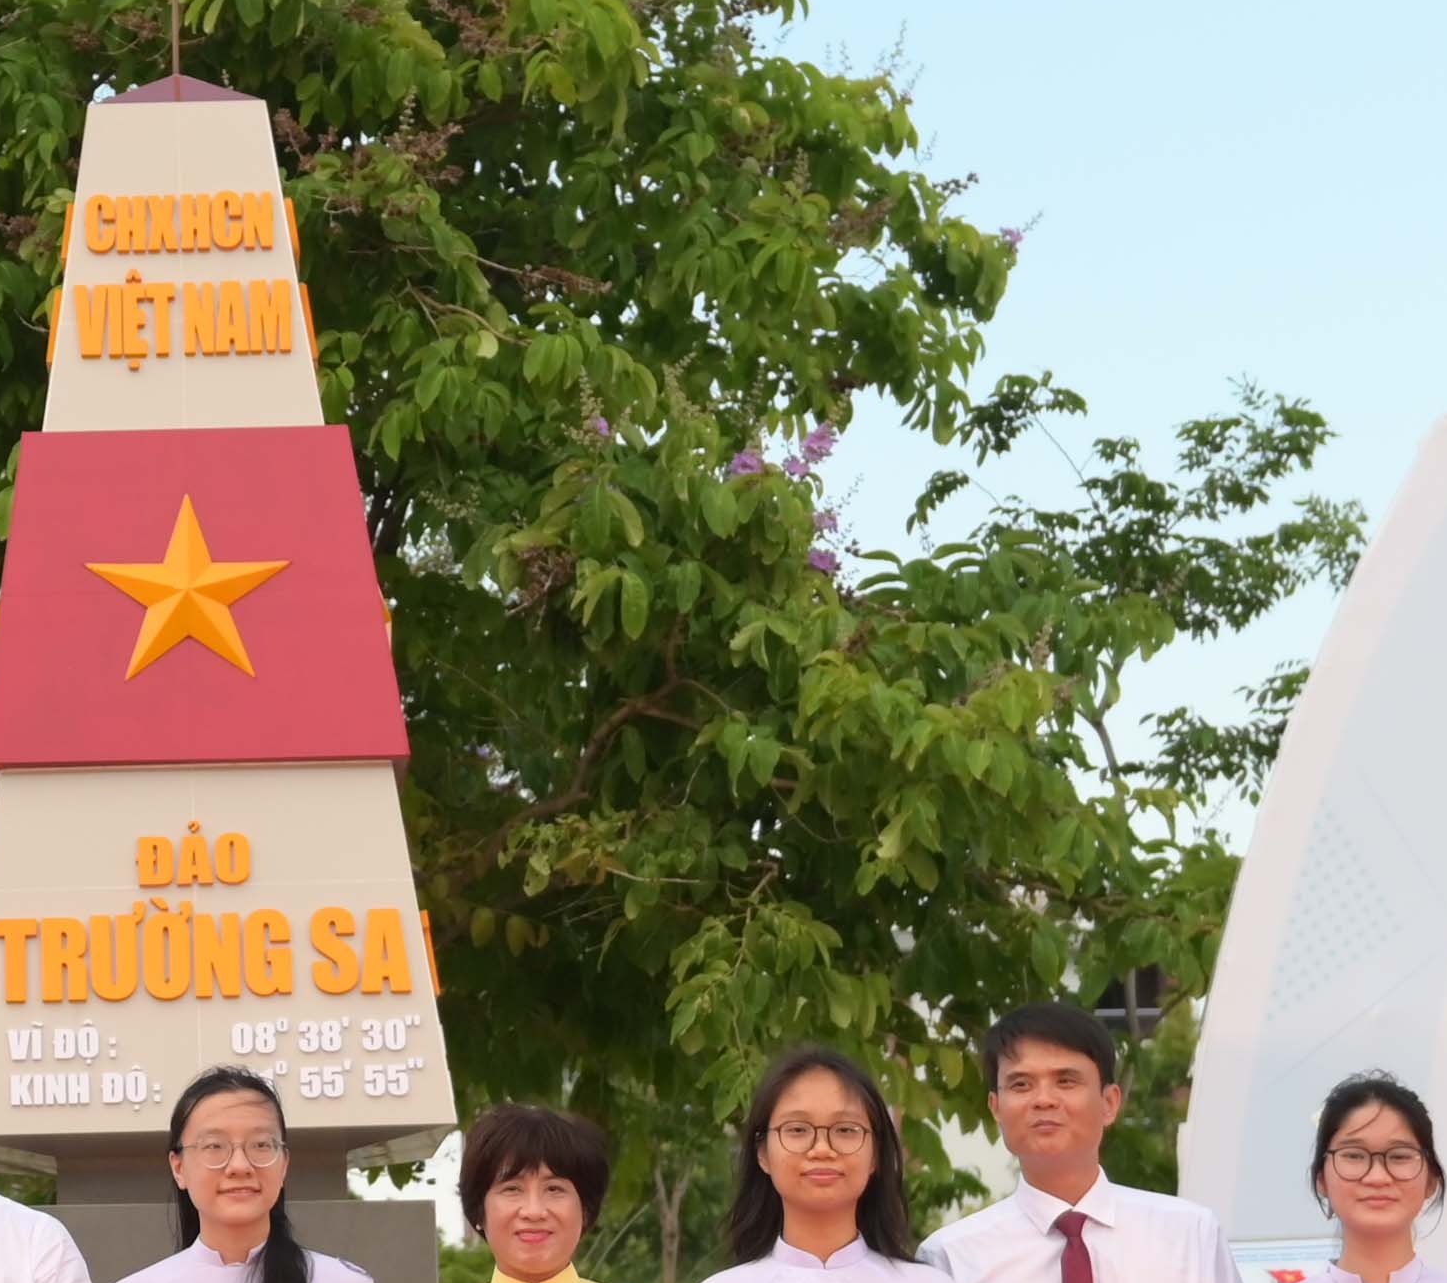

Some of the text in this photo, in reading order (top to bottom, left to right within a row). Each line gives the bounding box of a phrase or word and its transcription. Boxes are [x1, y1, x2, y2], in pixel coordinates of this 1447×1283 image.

[85, 190, 273, 254] CHXHCN
[74, 269, 292, 372] VIỆT NAM
[135, 820, 252, 887] ĐẢO
[310, 906, 412, 995] SA
[8, 1020, 43, 1061] VĨ
[10, 1072, 91, 1107] KINH
